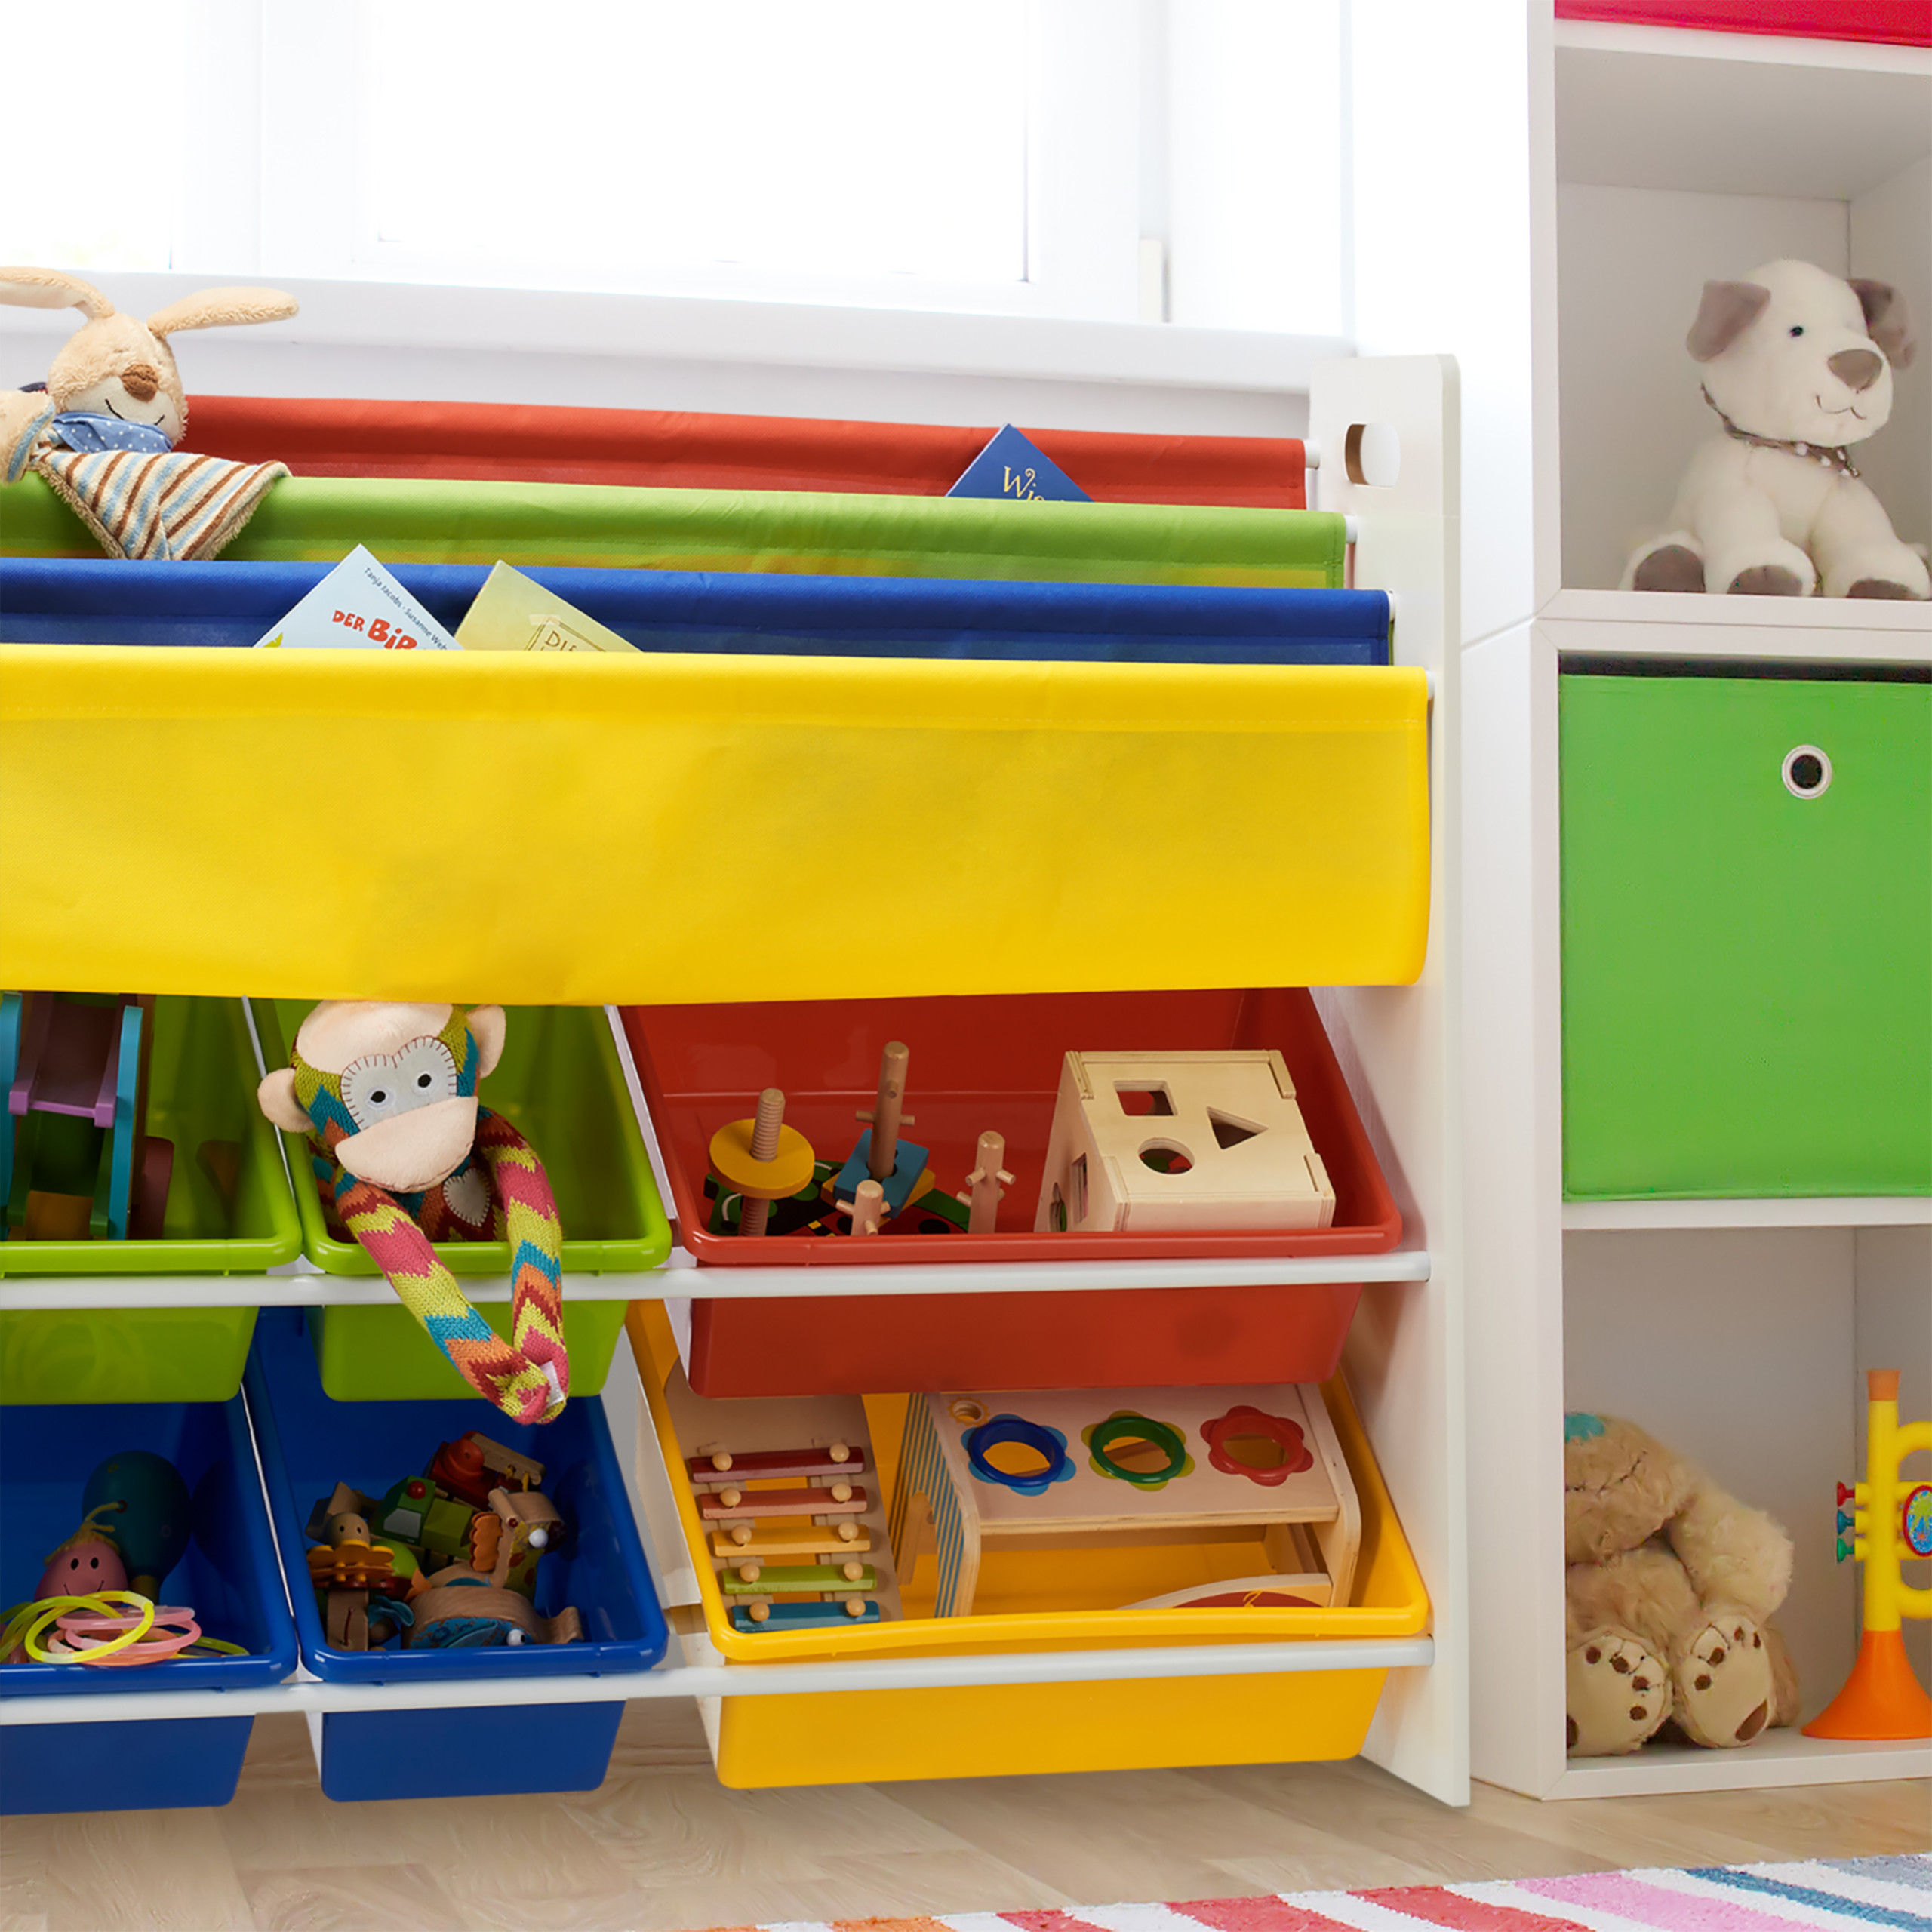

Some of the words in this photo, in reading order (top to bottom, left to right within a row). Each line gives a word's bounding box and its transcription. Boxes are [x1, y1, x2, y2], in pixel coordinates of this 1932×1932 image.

[332, 610, 365, 632] DER
[364, 567, 382, 588] Tanja
[380, 585, 402, 608] Jacobs
[404, 608, 432, 637] Susanne
